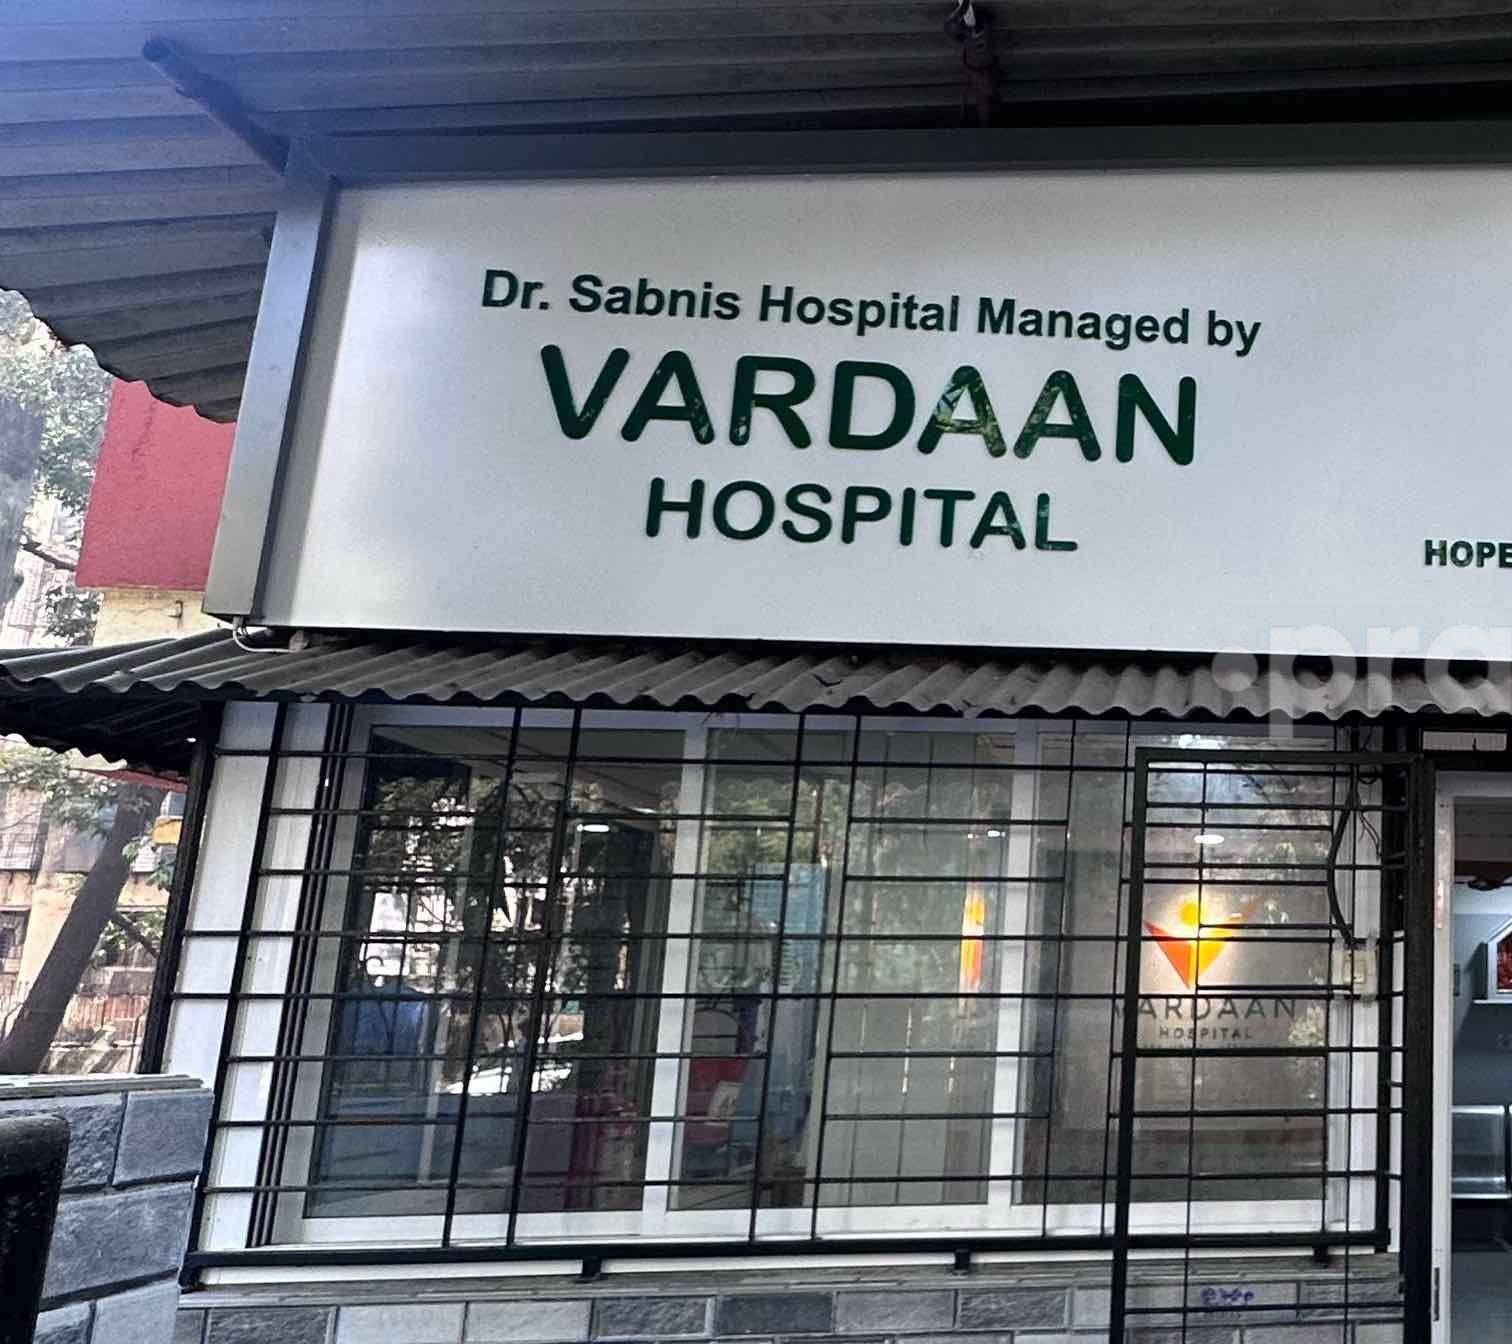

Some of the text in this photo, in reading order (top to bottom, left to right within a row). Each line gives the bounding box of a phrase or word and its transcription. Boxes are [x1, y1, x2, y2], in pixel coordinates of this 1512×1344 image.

[481, 268, 1261, 358] Dr. Sabnis Hospital Managed by
[540, 344, 1197, 466] VARDAAN
[646, 477, 1079, 552] HOSPITAL
[1115, 995, 1297, 1020] ARDAAN
